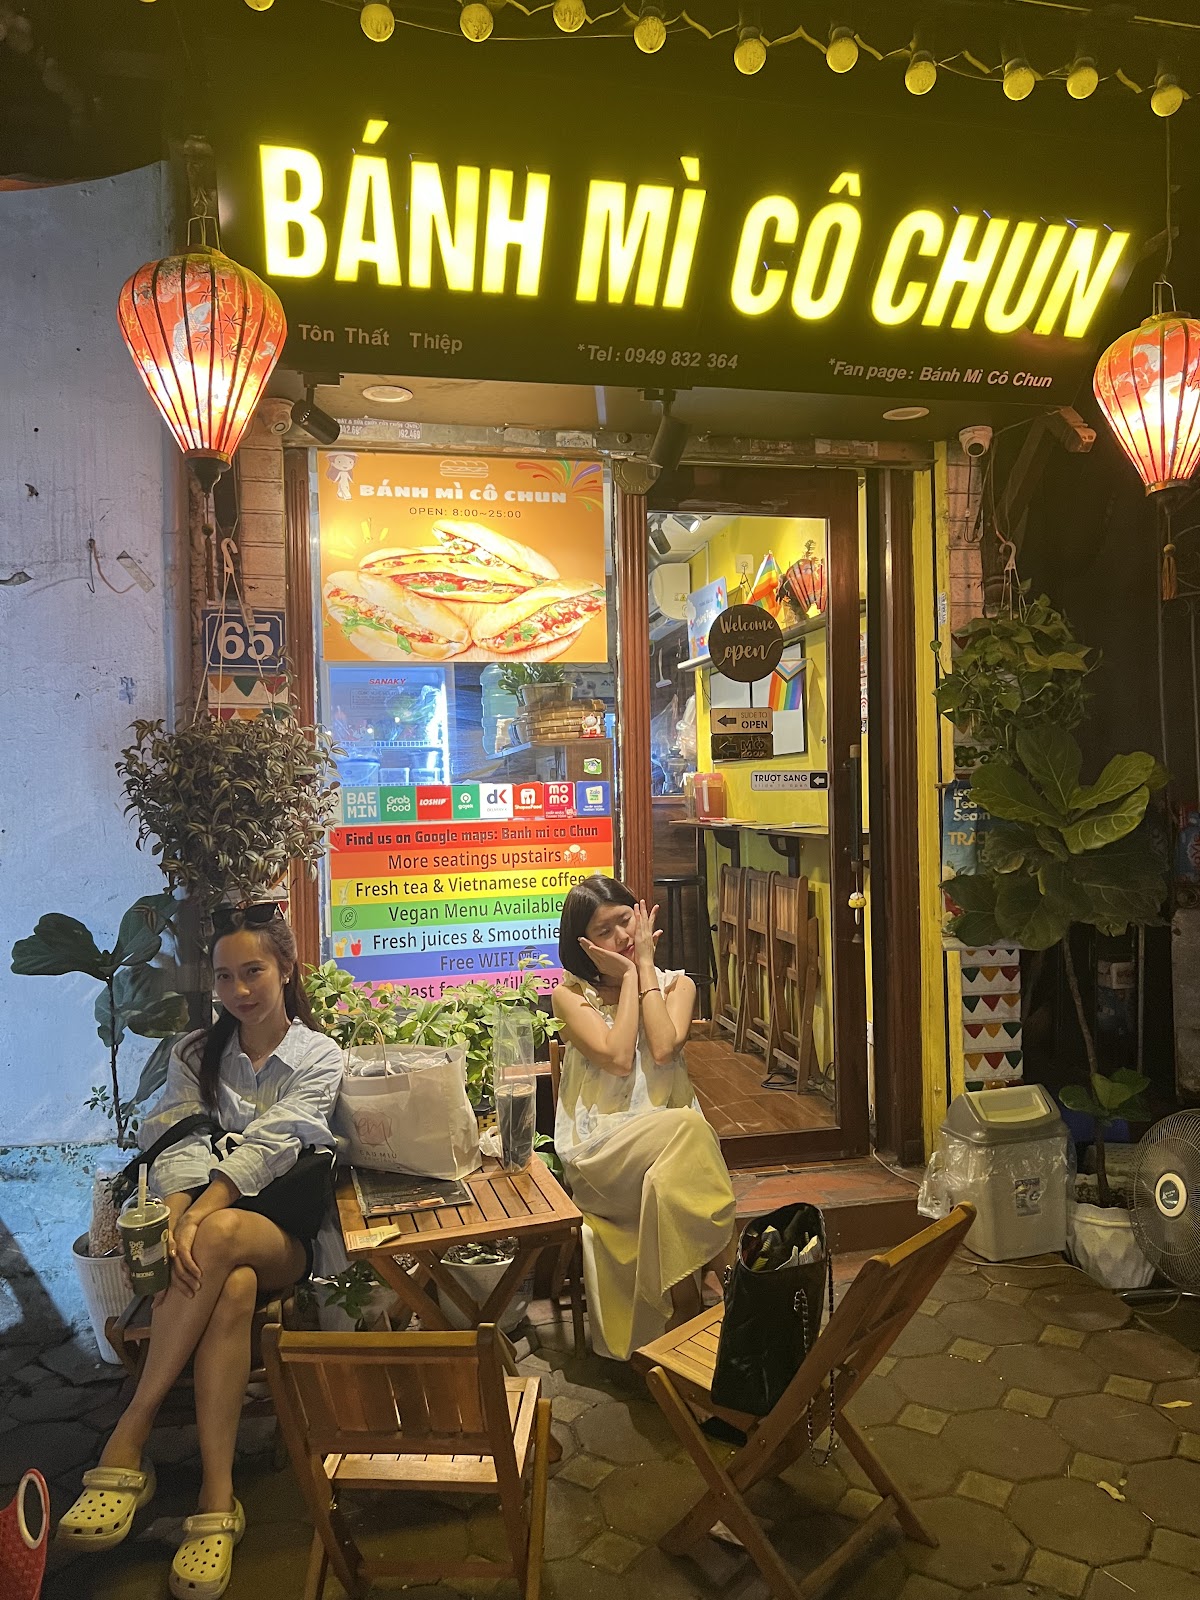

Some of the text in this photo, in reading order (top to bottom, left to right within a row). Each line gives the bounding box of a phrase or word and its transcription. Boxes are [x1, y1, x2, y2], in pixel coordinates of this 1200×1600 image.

[259, 119, 1131, 339] BÁNH MÌ CÔ CHUN
[298, 323, 463, 354] Tôn Thất Thiệp
[624, 347, 667, 365] 0949
[670, 351, 701, 367] 832
[706, 353, 739, 369] 364
[918, 366, 961, 383] Bánh
[962, 368, 984, 384] Mì
[986, 370, 1009, 386] Cô
[1011, 371, 1053, 388] Chun
[359, 479, 568, 504] BÁNH MÌ CÔ CHUN
[409, 506, 448, 517] OPEN:
[720, 615, 775, 633] Welcome
[217, 621, 274, 660] 65
[718, 640, 780, 667] open
[740, 711, 759, 719] SLIDE
[741, 720, 768, 729] OPEN
[754, 773, 808, 784] TRƯỢT SANG
[346, 791, 377, 805] BAE
[386, 795, 411, 805] Grab
[386, 803, 411, 813] Food
[419, 798, 448, 806] LOSHIP
[952, 796, 978, 809] Tea
[347, 805, 377, 819] MIN
[345, 824, 598, 846] Find us on Google maps: Banh mi co Chun
[388, 847, 562, 870] More seatings upstairs
[355, 871, 586, 897] Fresh tea & Vietnamese coffee
[388, 897, 564, 925] Vegan Menu Available
[373, 931, 417, 950] Fresh
[420, 930, 468, 952] juices
[472, 928, 484, 943] &
[440, 951, 515, 971] Free WIFI
[404, 983, 435, 999] ast
